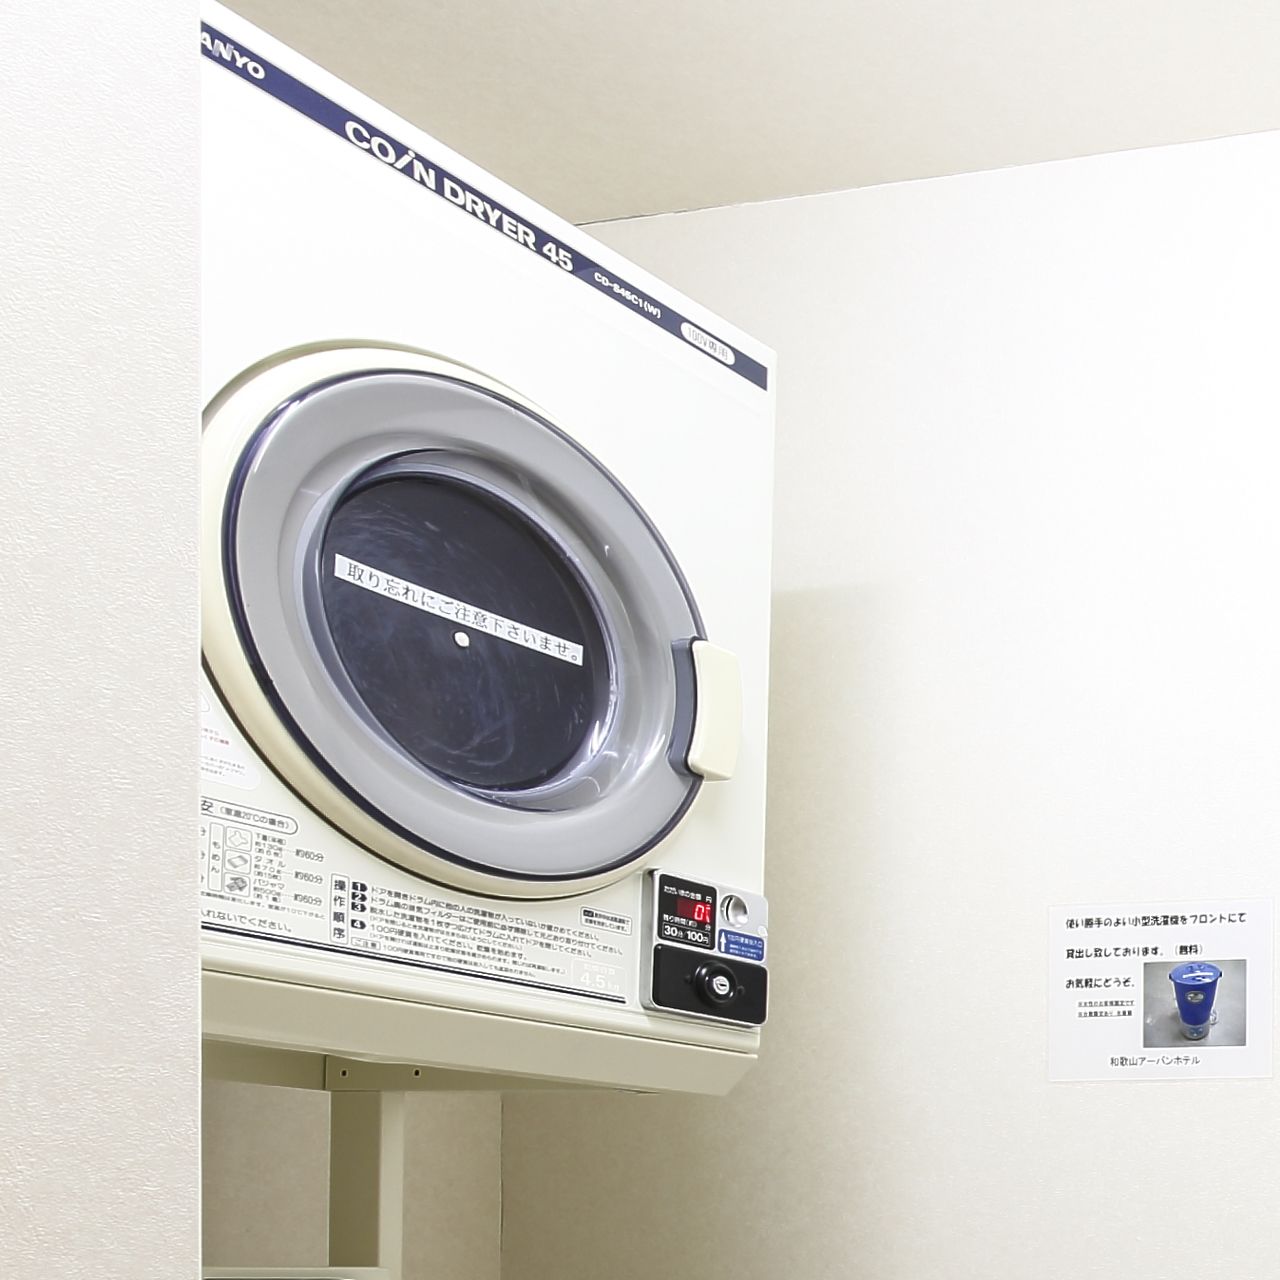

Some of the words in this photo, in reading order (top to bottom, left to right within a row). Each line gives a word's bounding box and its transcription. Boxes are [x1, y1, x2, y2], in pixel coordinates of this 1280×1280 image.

[444, 177, 536, 251] DRYER
[543, 242, 573, 272] 45
[347, 561, 578, 662] 取り忘れにご注意下さいませ。
[1110, 1056, 1201, 1068] 和歌山アーバンホテル
